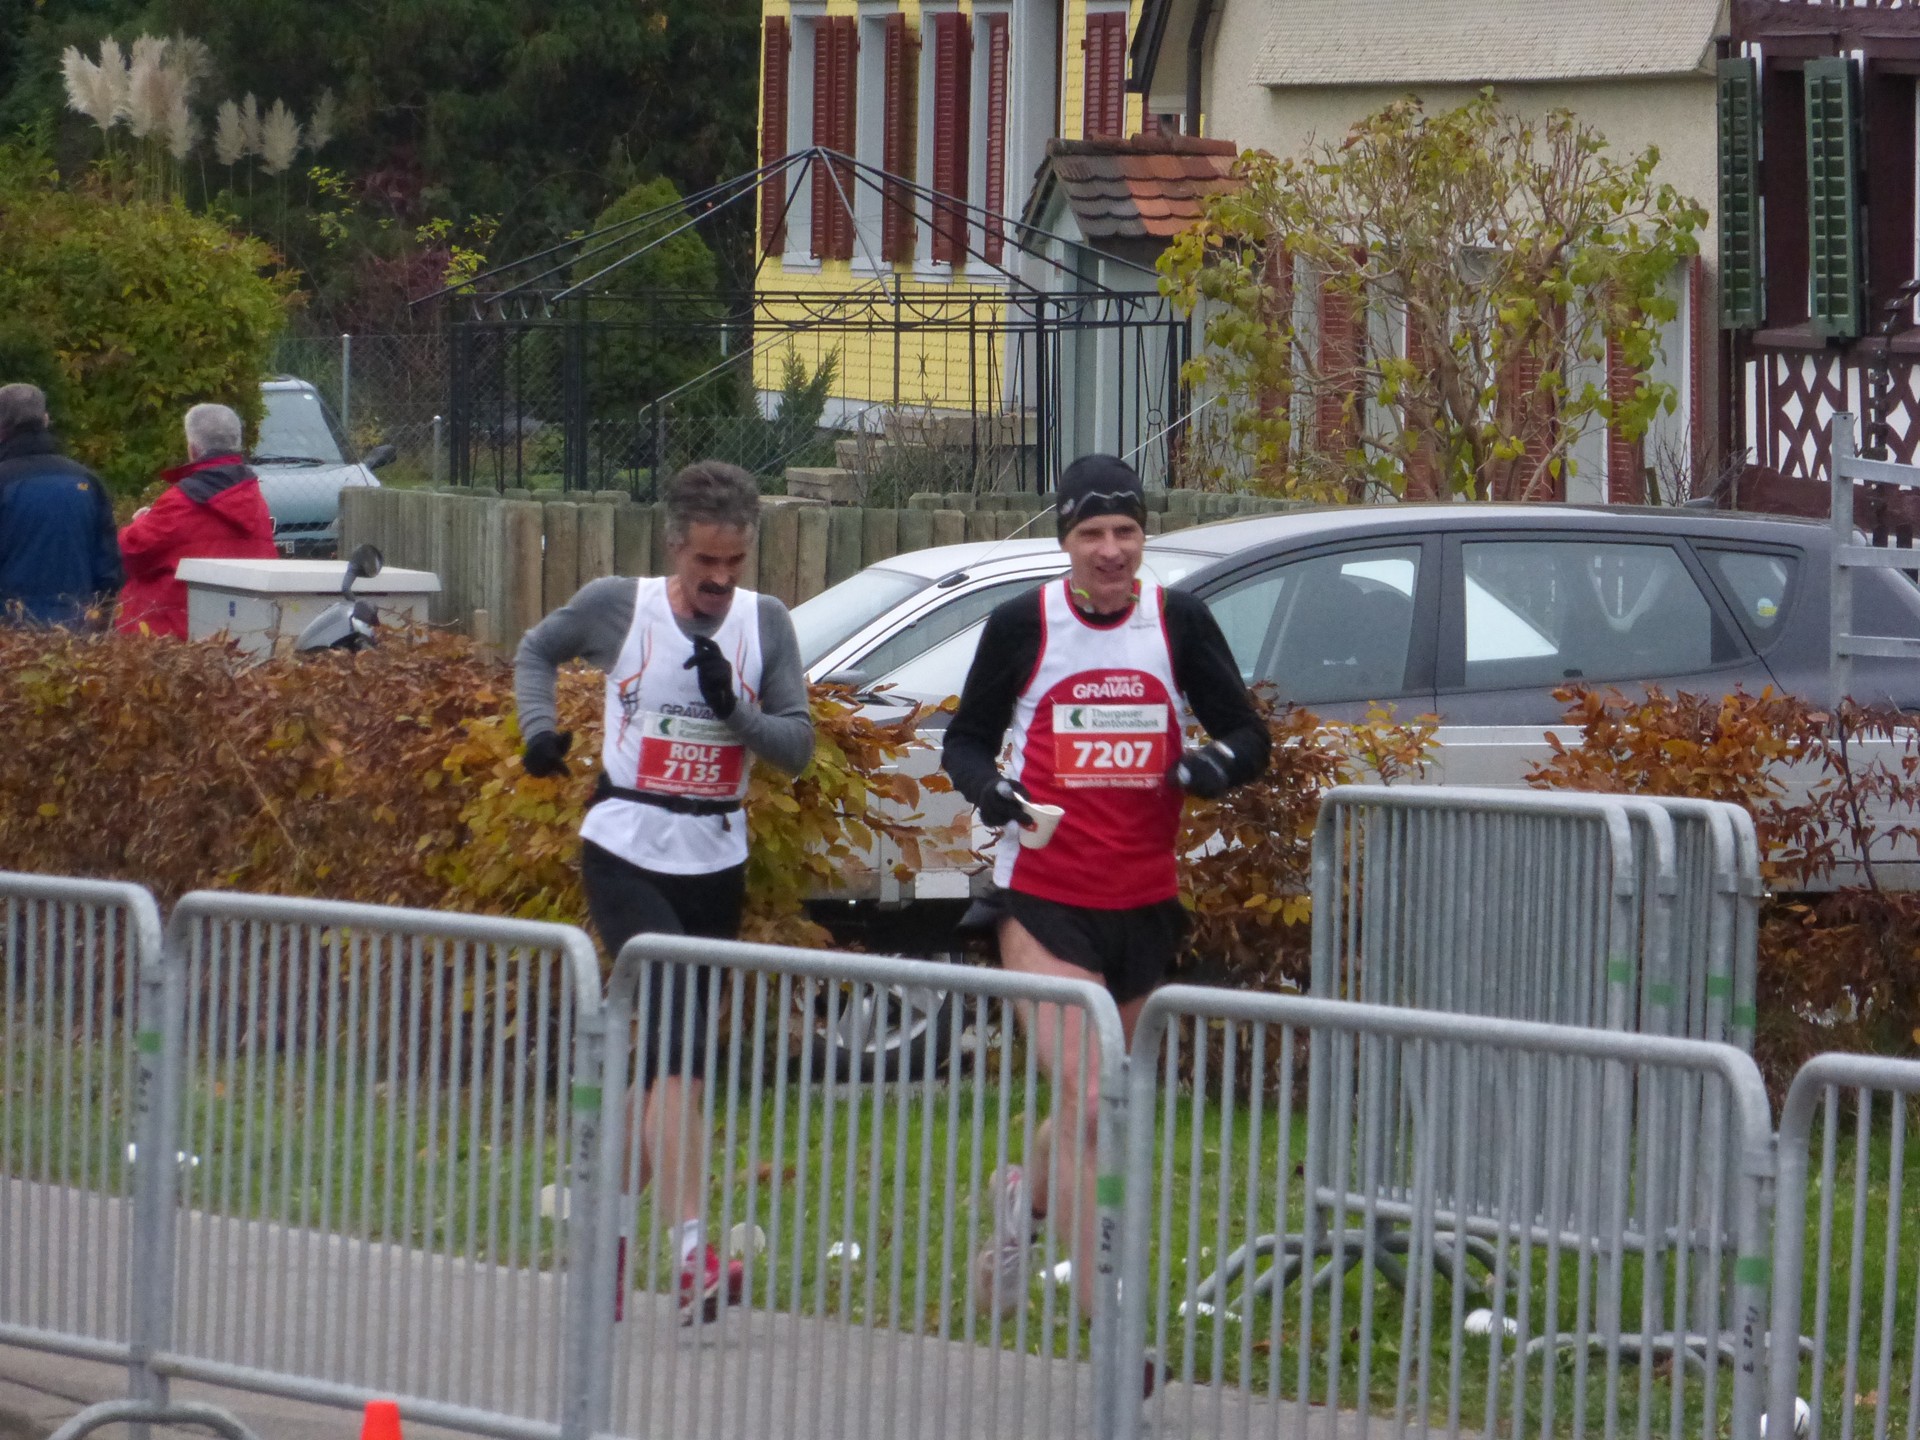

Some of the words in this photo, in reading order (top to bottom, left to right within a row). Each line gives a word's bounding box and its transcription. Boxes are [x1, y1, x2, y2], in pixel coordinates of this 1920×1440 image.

[1072, 682, 1146, 699] GRAVAG
[660, 703, 714, 720] GRAVA
[1091, 708, 1143, 720] Thurgauer
[1091, 718, 1159, 729] Kantonalbank
[669, 743, 721, 763] ROLF
[1073, 740, 1153, 769] 7207
[663, 760, 722, 783] 7135
